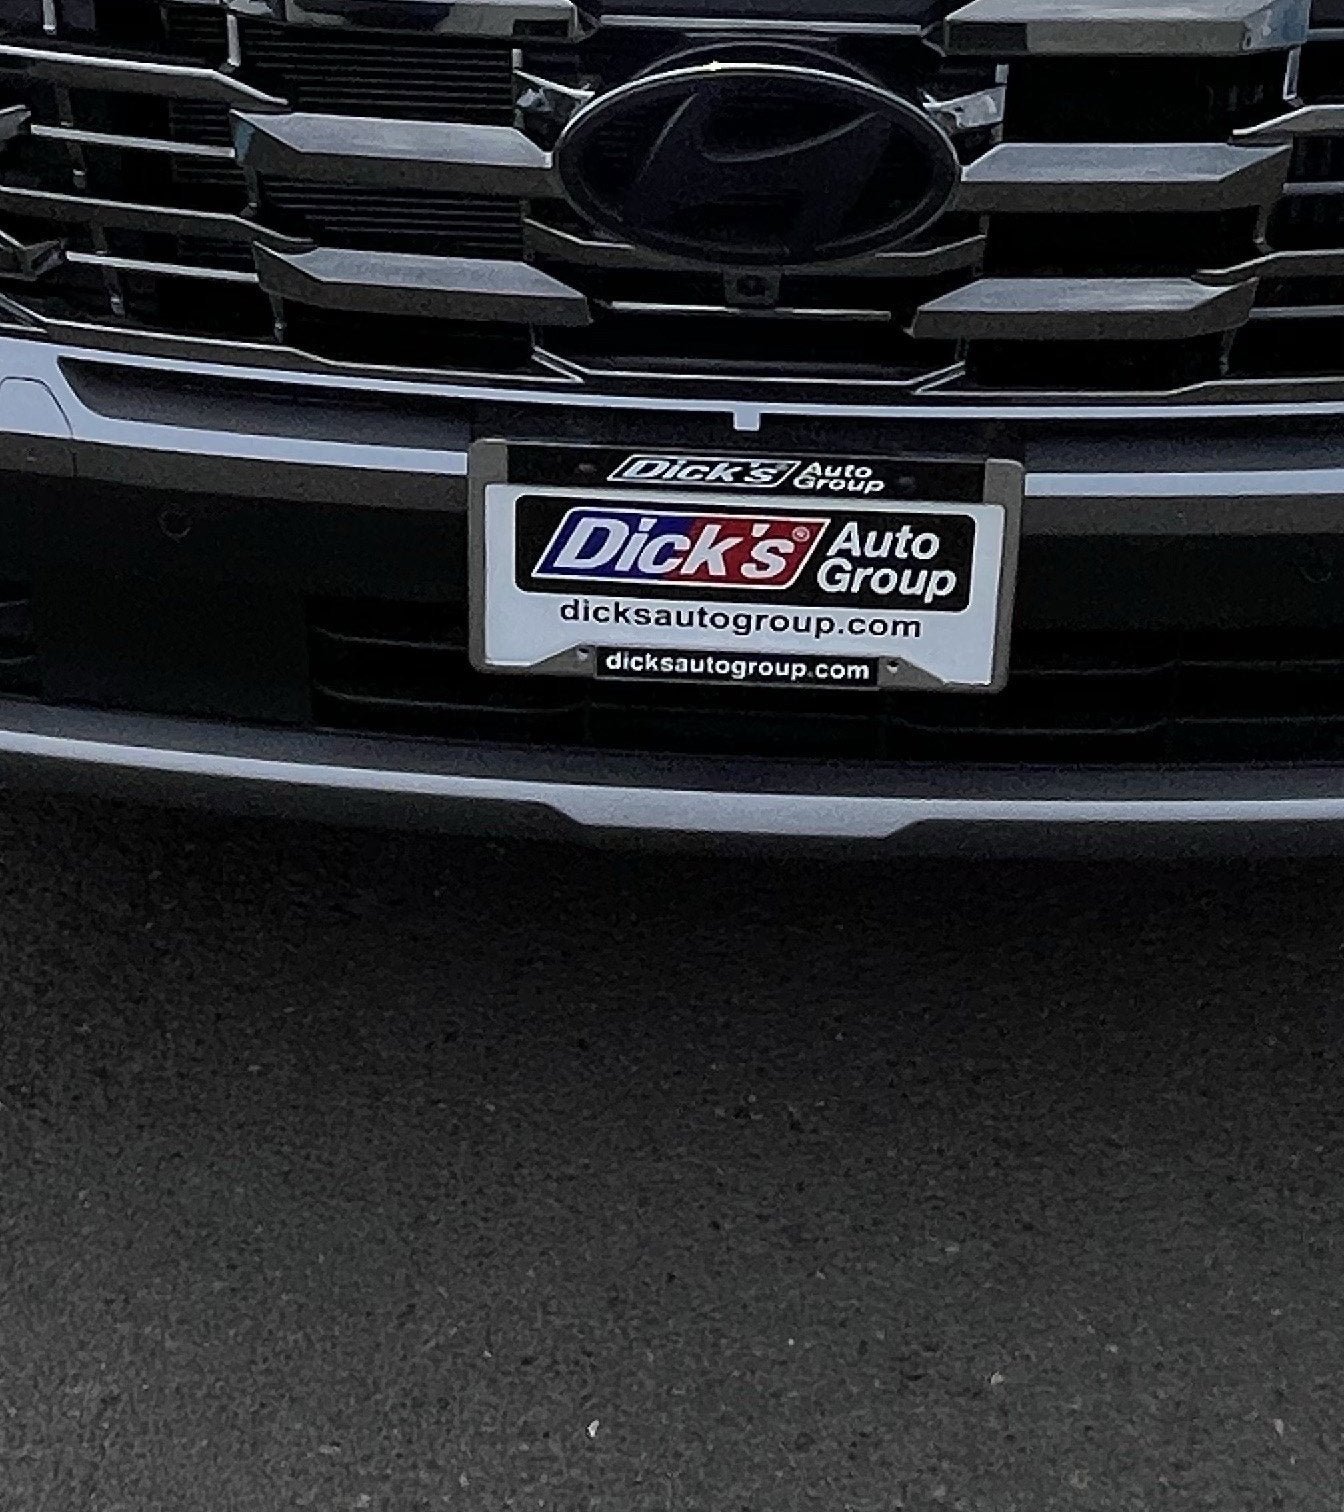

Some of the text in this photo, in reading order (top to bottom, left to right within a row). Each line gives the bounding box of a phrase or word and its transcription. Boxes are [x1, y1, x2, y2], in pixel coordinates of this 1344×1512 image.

[792, 476, 885, 494] Group
[802, 461, 873, 478] Auto
[825, 520, 942, 560] Auto
[816, 557, 958, 604] Group
[559, 598, 922, 638] dicksautogroup.com
[605, 650, 870, 681] dicksautogroup.com
